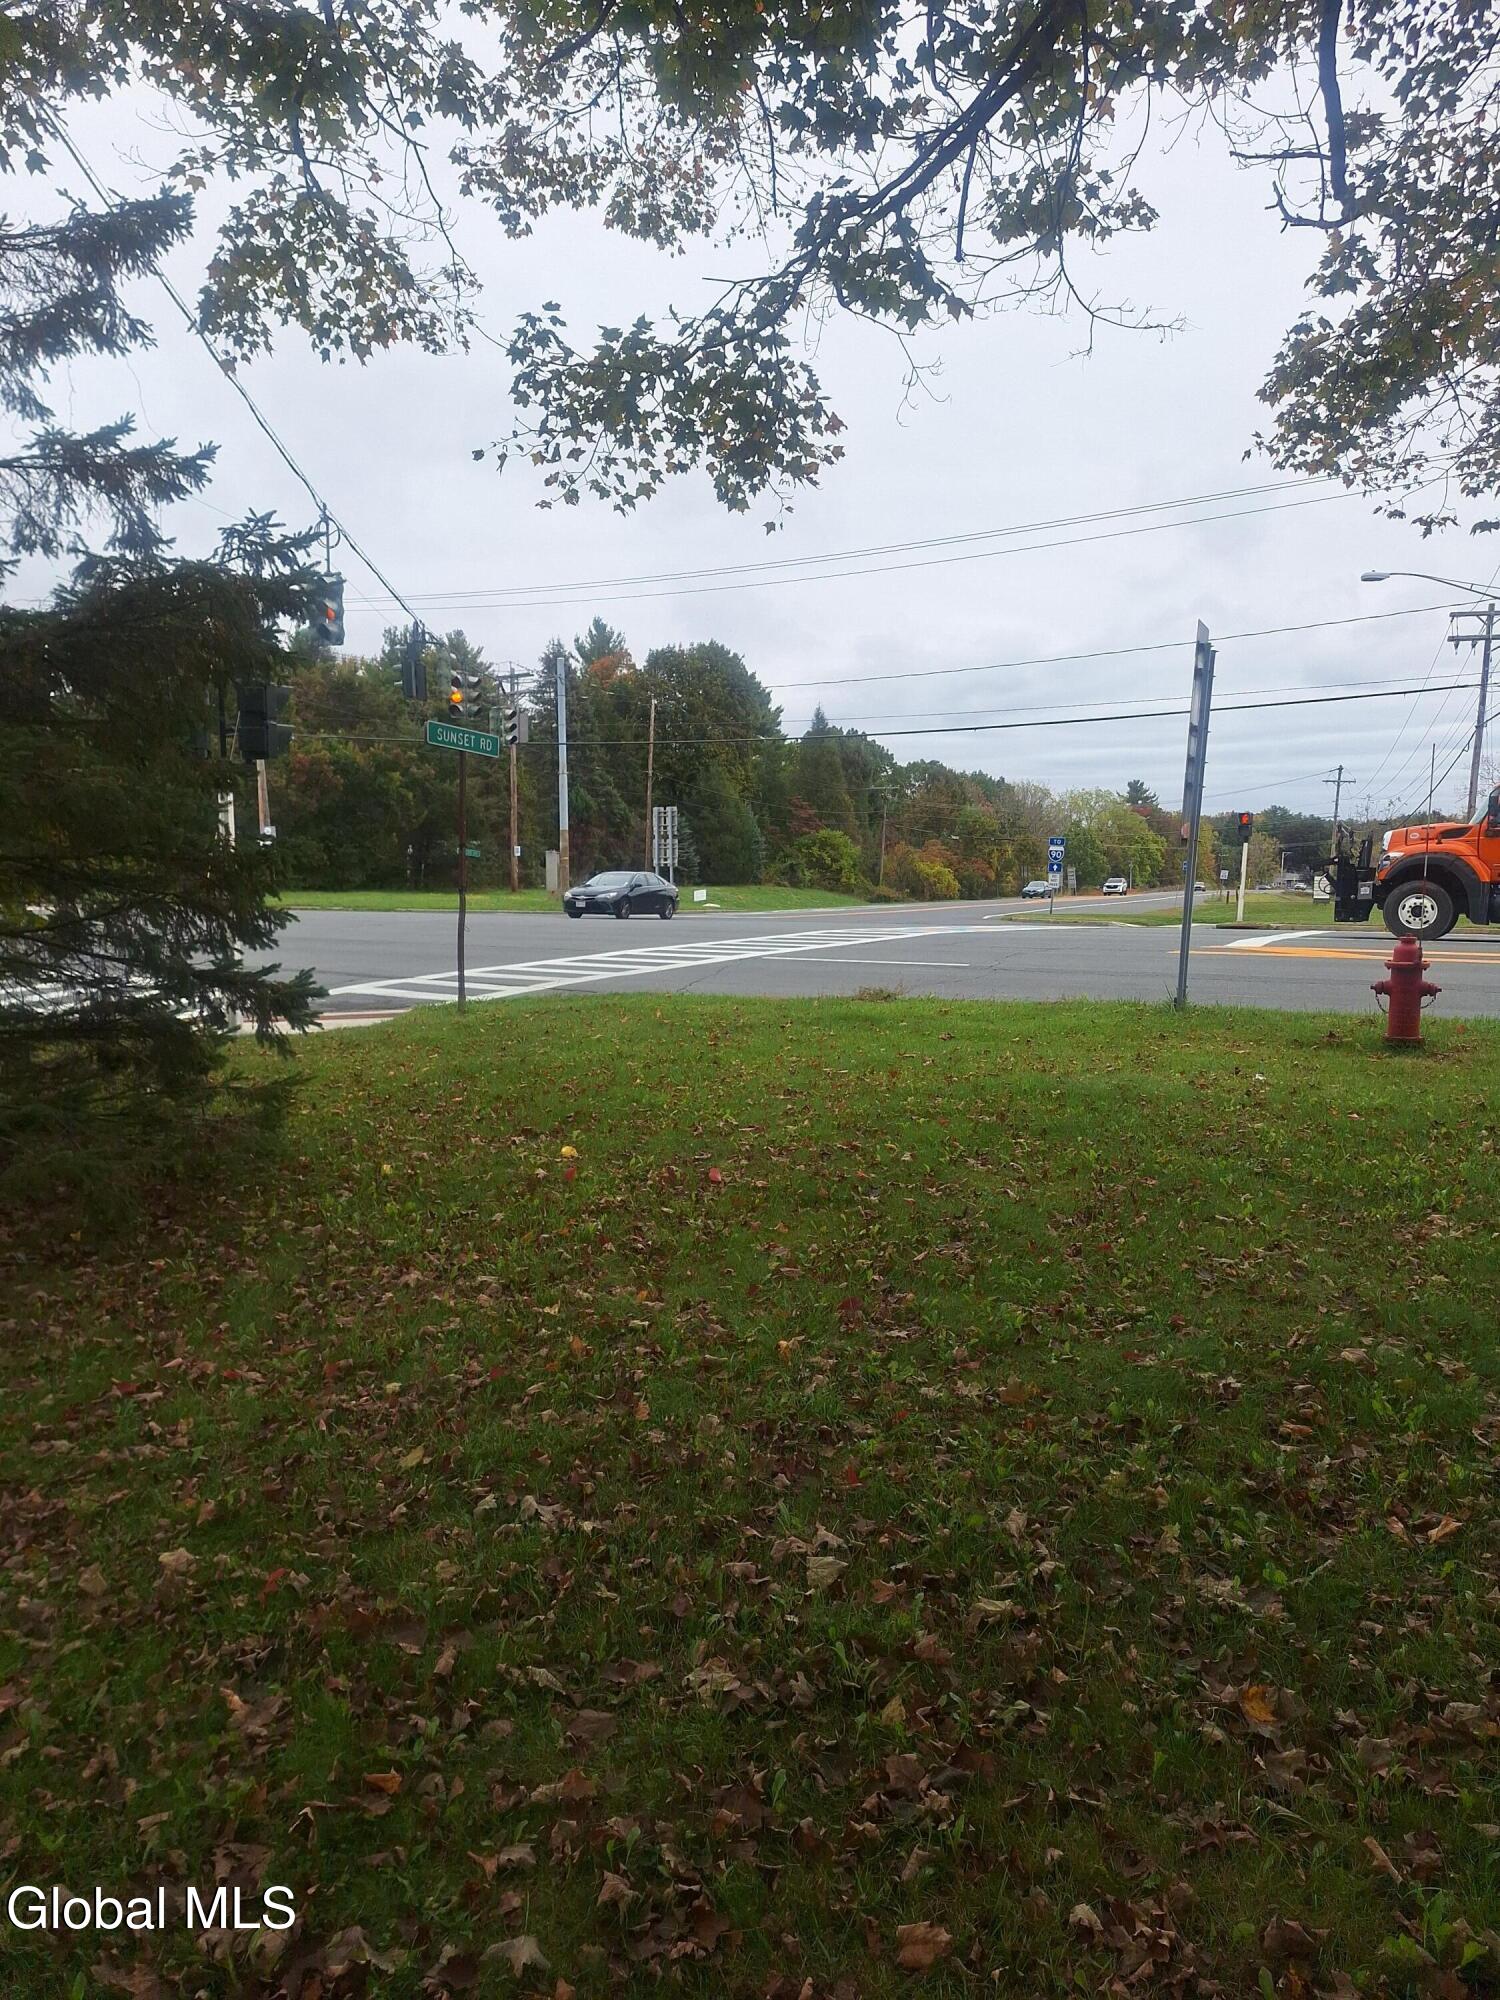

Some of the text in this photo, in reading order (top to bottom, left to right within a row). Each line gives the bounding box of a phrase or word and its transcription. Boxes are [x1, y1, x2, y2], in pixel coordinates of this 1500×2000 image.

[437, 728, 492, 751] SUNSET RD
[1050, 850, 1062, 859] 90
